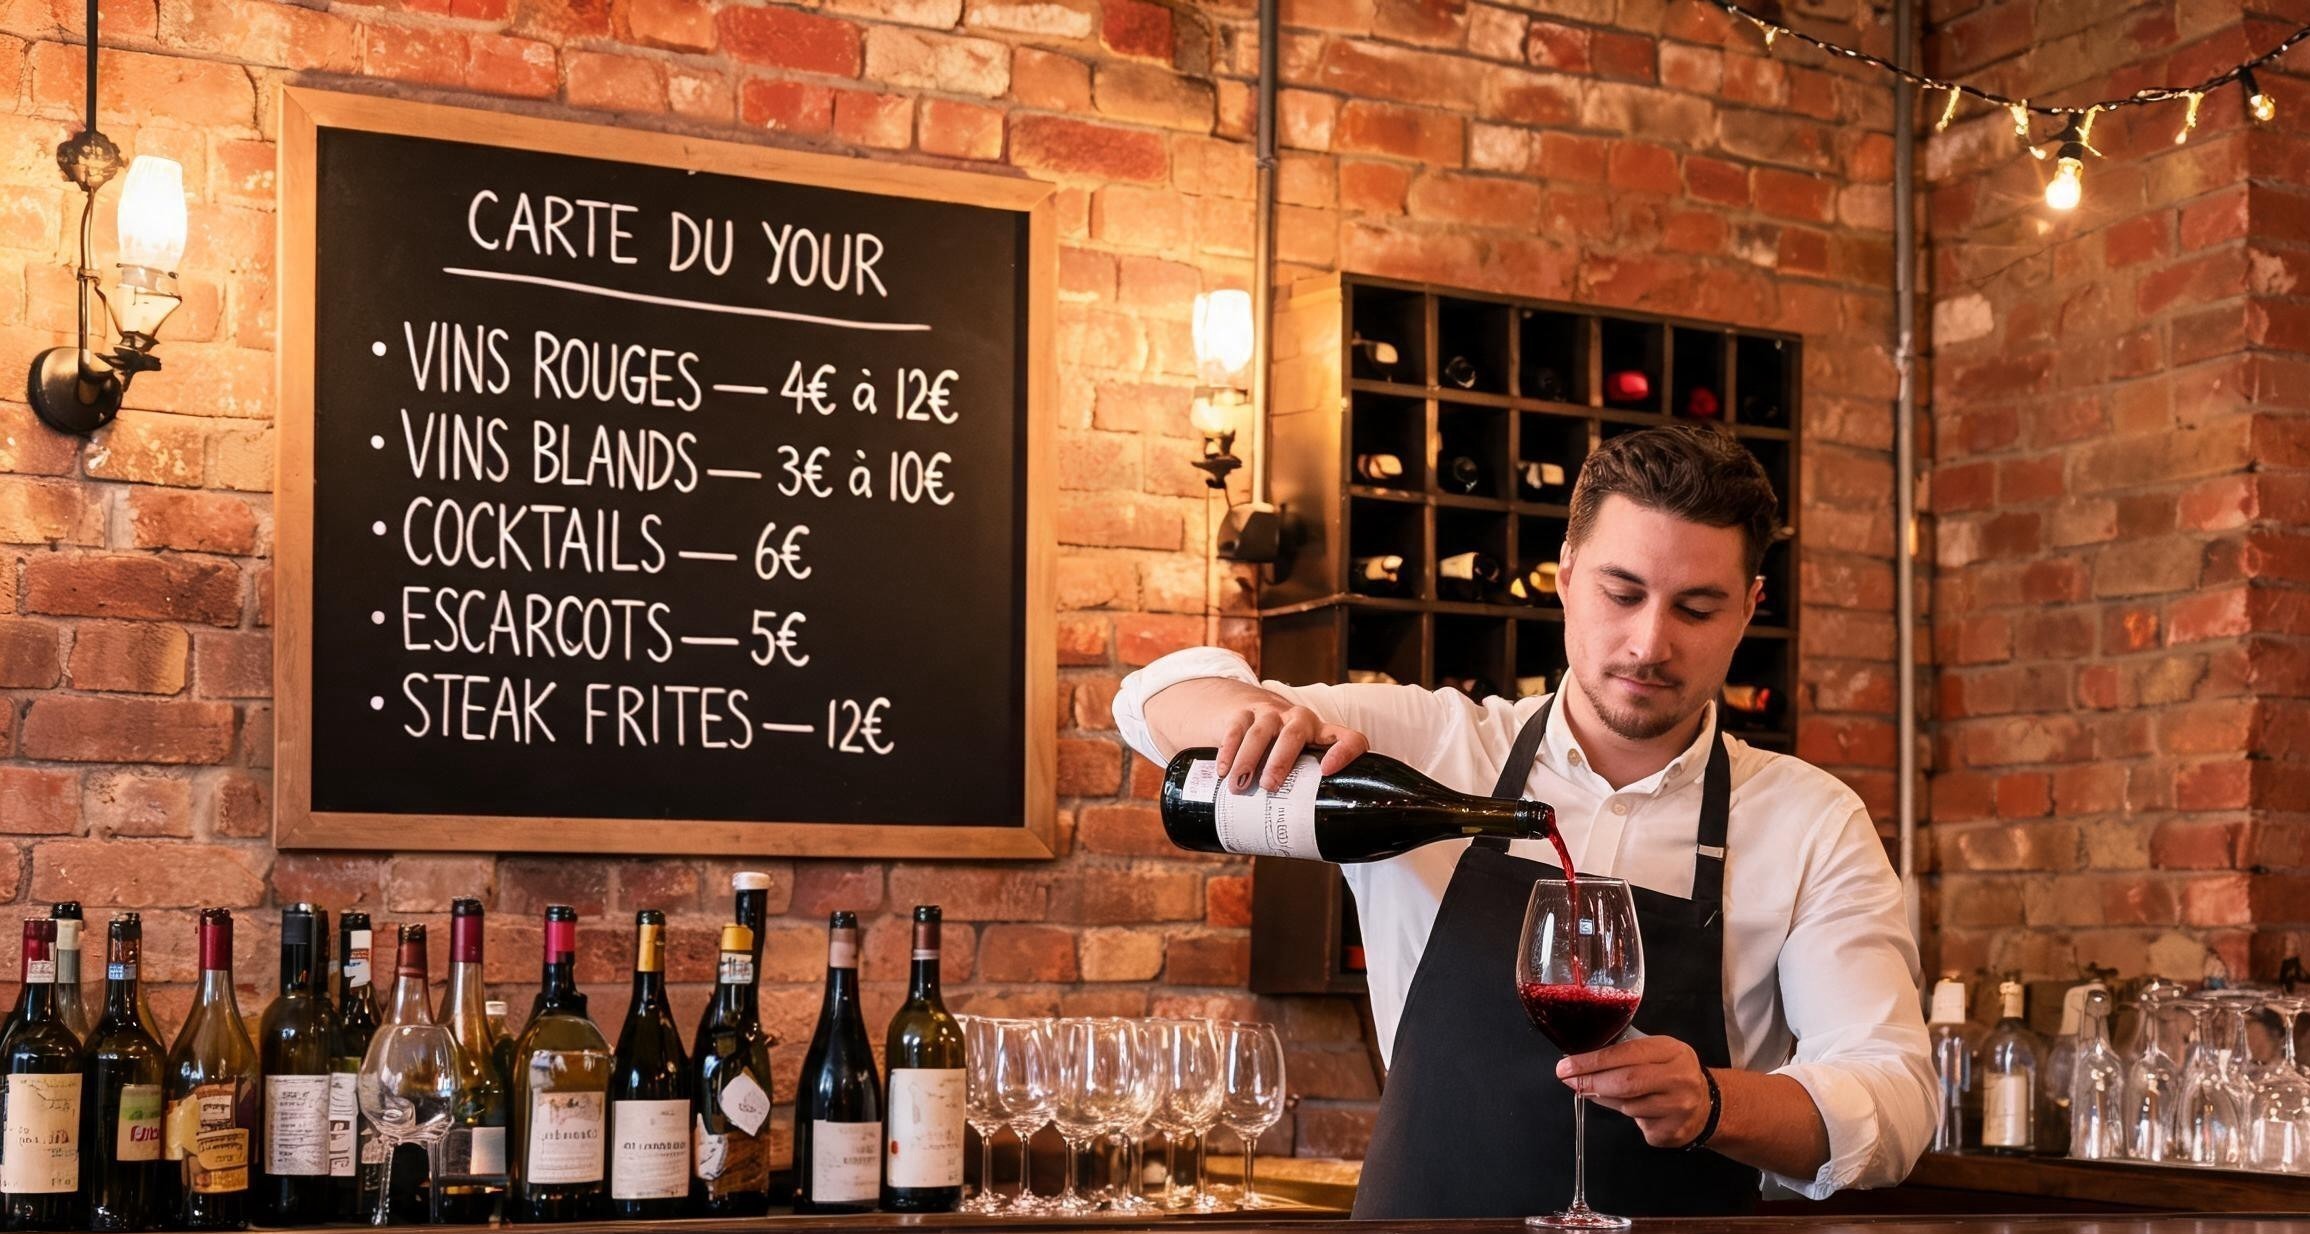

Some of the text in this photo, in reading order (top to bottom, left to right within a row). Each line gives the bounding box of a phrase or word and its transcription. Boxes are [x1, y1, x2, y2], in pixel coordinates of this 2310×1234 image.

[468, 189, 889, 298] CARTE DU YOUR
[403, 320, 511, 395] VINS
[534, 330, 702, 412] ROUGES
[780, 360, 837, 416] 4€
[852, 368, 878, 415] à
[896, 367, 960, 425] 12€
[400, 408, 510, 483] VINS
[533, 419, 698, 494] BLANDS
[777, 444, 833, 498] 3€
[848, 449, 873, 499] à
[889, 450, 955, 506] 10€
[403, 495, 666, 574] COCKTAILS
[754, 521, 812, 581] 6€
[750, 609, 810, 668] 5€
[402, 672, 557, 745] STEAK
[585, 683, 753, 750] FRITES
[827, 697, 895, 755] 12€
